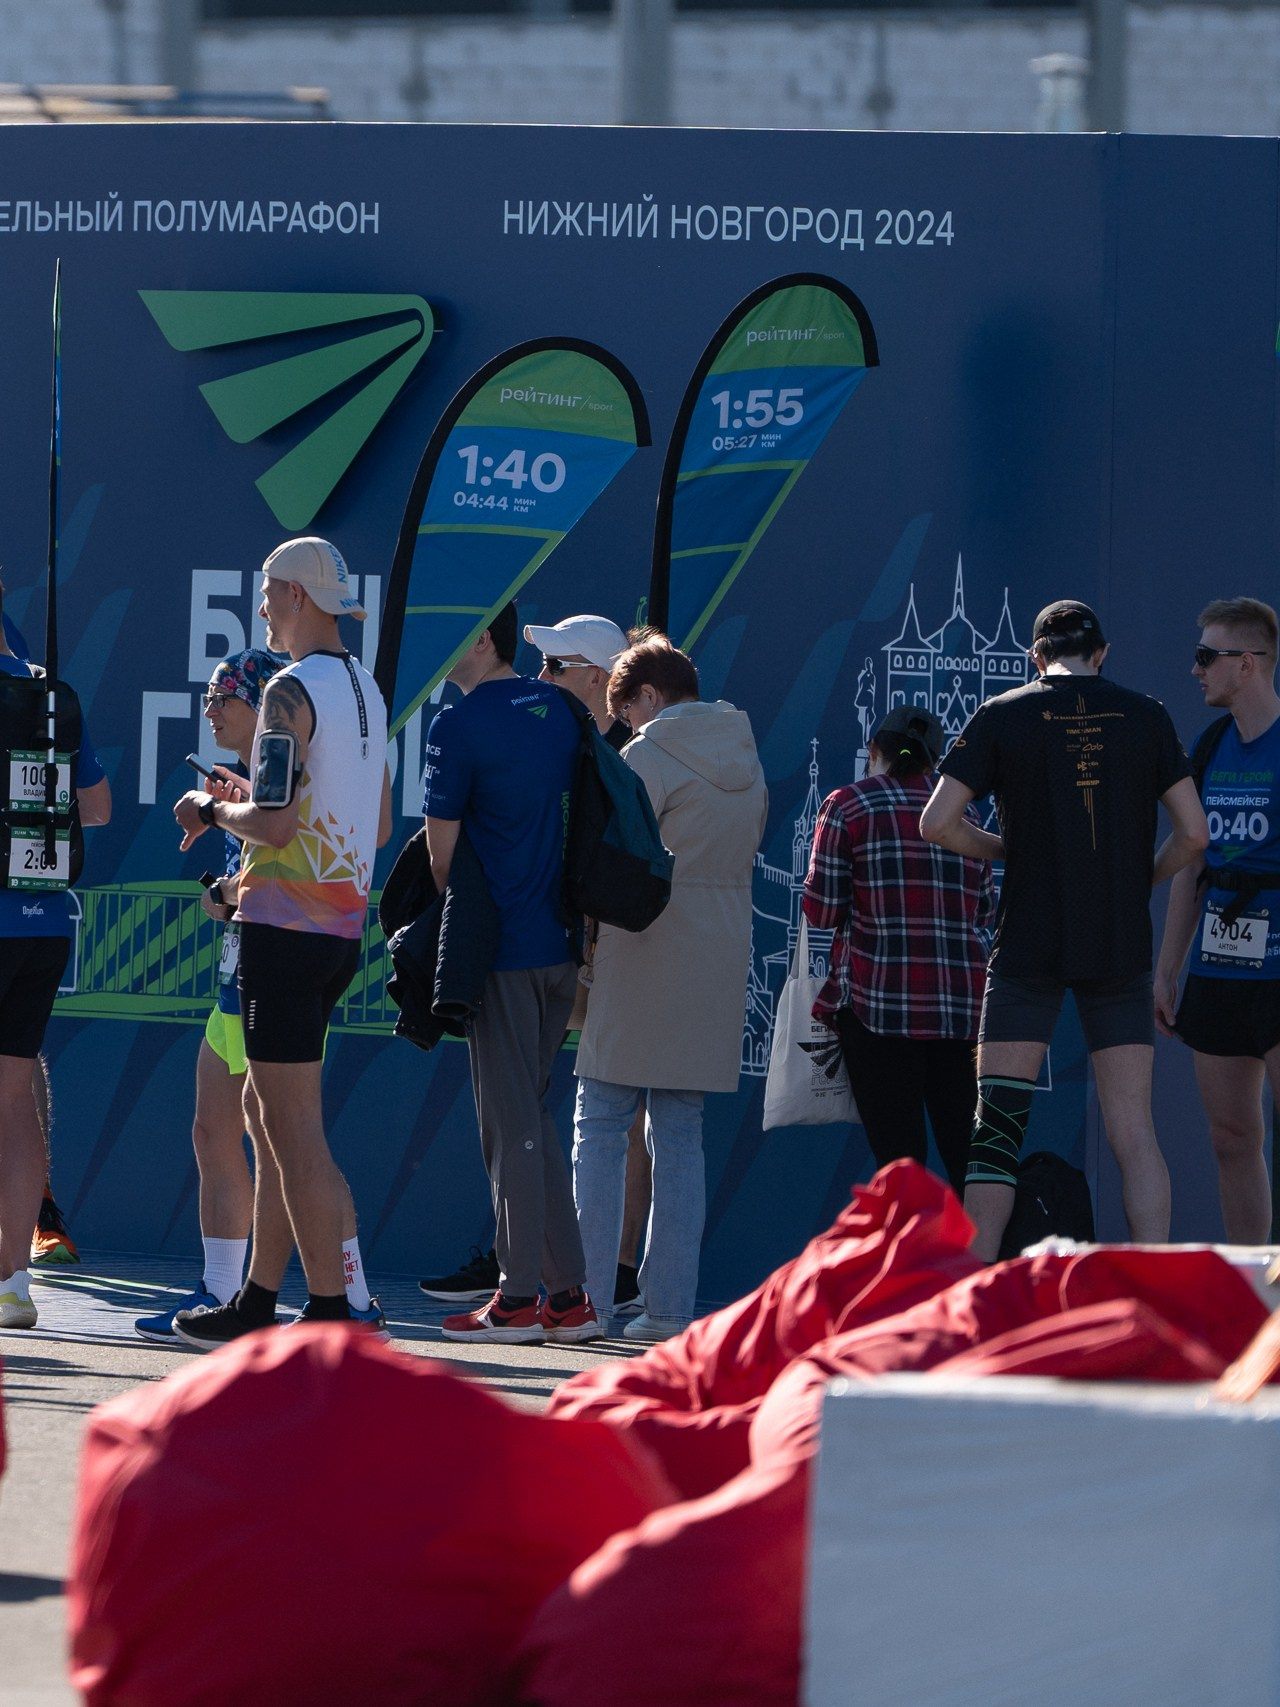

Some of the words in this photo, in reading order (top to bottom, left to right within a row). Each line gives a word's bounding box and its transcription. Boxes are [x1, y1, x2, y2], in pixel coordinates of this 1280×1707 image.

[133, 200, 380, 234] ПОЛУМАРАФОН
[503, 193, 659, 238] НИЖНИЙ
[671, 204, 865, 251] НОВГОРОД
[875, 209, 955, 246] 2024
[711, 387, 805, 429] 1:55
[712, 434, 758, 451] 05:27
[457, 444, 567, 494] 1:40
[453, 491, 509, 511] 04:44
[1206, 794, 1270, 806] ПЕЙСМЕЙКЕР
[1207, 811, 1269, 842] 0:40
[1210, 918, 1253, 943] 4904
[1218, 943, 1238, 951] АНТОН
